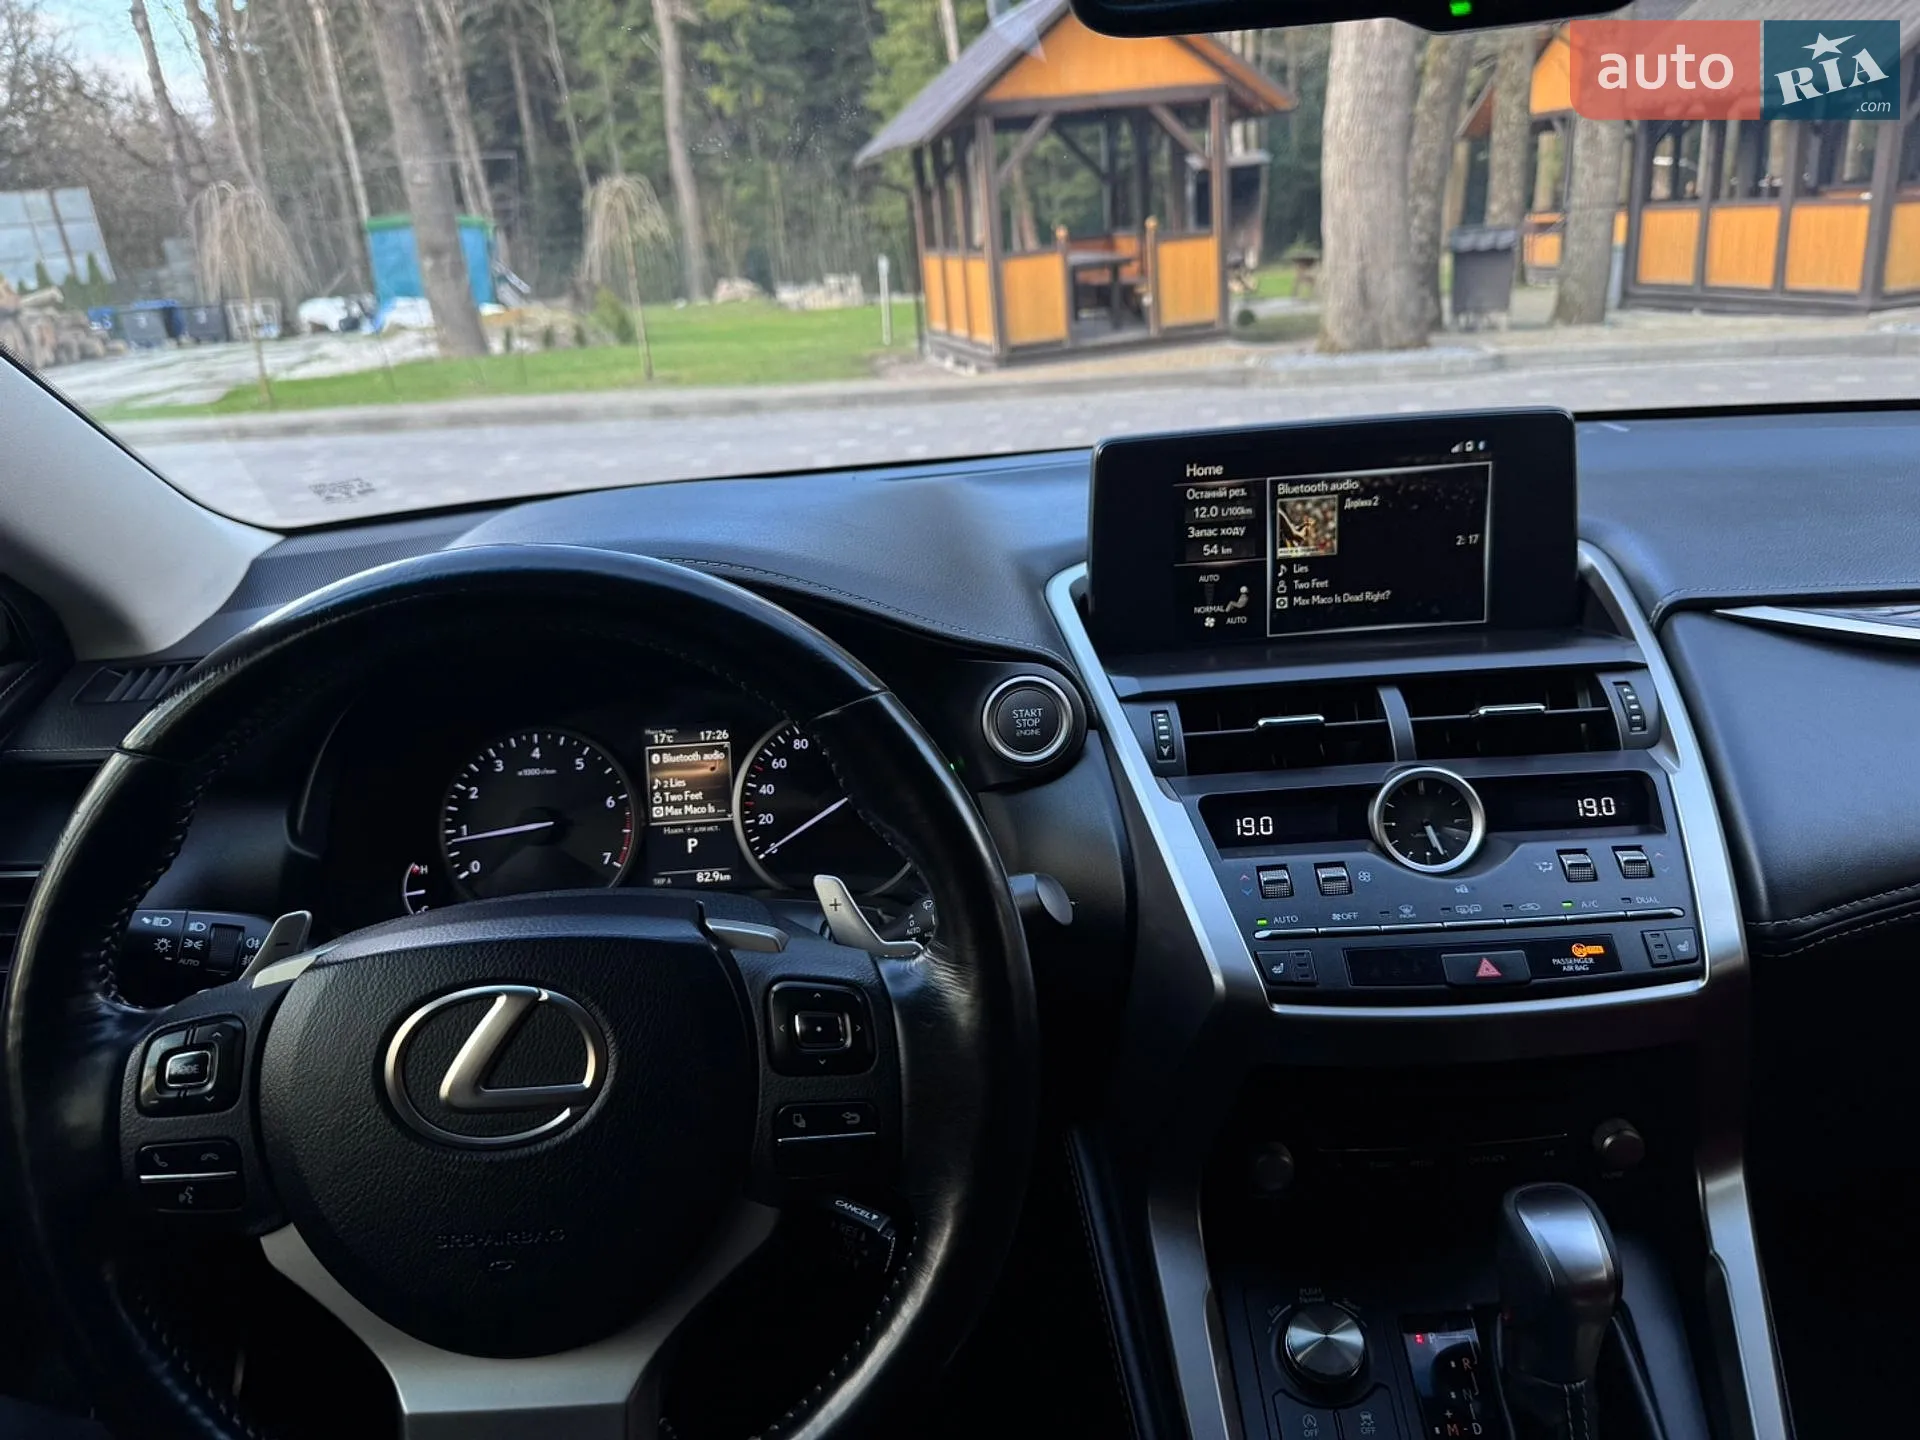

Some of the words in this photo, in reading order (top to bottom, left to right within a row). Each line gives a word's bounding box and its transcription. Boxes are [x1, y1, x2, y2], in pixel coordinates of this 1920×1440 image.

[1186, 463, 1223, 477] Home
[1277, 481, 1328, 495] Bluetooth
[1330, 479, 1359, 491] audio
[1372, 495, 1380, 506] 2
[1194, 505, 1218, 518] 12.0
[1188, 526, 1218, 538] Запас
[1220, 526, 1246, 537] ходу
[1203, 544, 1218, 556] 54
[1221, 546, 1232, 555] km
[1293, 563, 1309, 574] Lies
[1199, 574, 1220, 583] AUTO
[1293, 579, 1310, 590] Two
[1311, 578, 1329, 588] Feet
[1343, 593, 1363, 602] Dead
[1365, 590, 1392, 603] Right?
[1193, 605, 1225, 614] NORMAL
[1226, 616, 1247, 624] AUTO
[1012, 708, 1043, 719] START
[1016, 718, 1040, 728] STOP
[700, 729, 729, 741] 17:26
[1016, 729, 1040, 737] ENGINE
[793, 739, 809, 750] 80
[531, 747, 541, 760] 4
[662, 751, 701, 763] Bluetooth
[703, 749, 725, 760] audio
[494, 760, 504, 772] 3
[575, 758, 585, 770] 5
[772, 758, 787, 769] 60
[670, 778, 686, 788] Lies
[468, 786, 479, 799] 2
[759, 784, 775, 795] 40
[605, 796, 615, 808] 6
[663, 792, 683, 802] Two
[684, 790, 703, 801] Feet
[665, 806, 682, 816] Max
[684, 804, 707, 815] Maco
[1577, 797, 1616, 817] 19.0
[758, 814, 774, 825] 20
[1236, 815, 1273, 836] 19.0
[460, 825, 468, 837] 1
[687, 838, 698, 854] P
[602, 852, 612, 865] 7
[420, 864, 429, 875] H
[470, 861, 481, 873] 0
[1636, 895, 1660, 904] DUAL
[1273, 914, 1298, 924] AUTO
[1342, 911, 1359, 920] OFF
[178, 957, 200, 967] AUTO
[1552, 957, 1595, 965] PASSENGER
[835, 1199, 873, 1220] CANCEL
[1462, 1356, 1472, 1371] R
[1303, 1429, 1318, 1438] OFF
[1446, 1423, 1460, 1437] M
[1472, 1422, 1483, 1436] D
